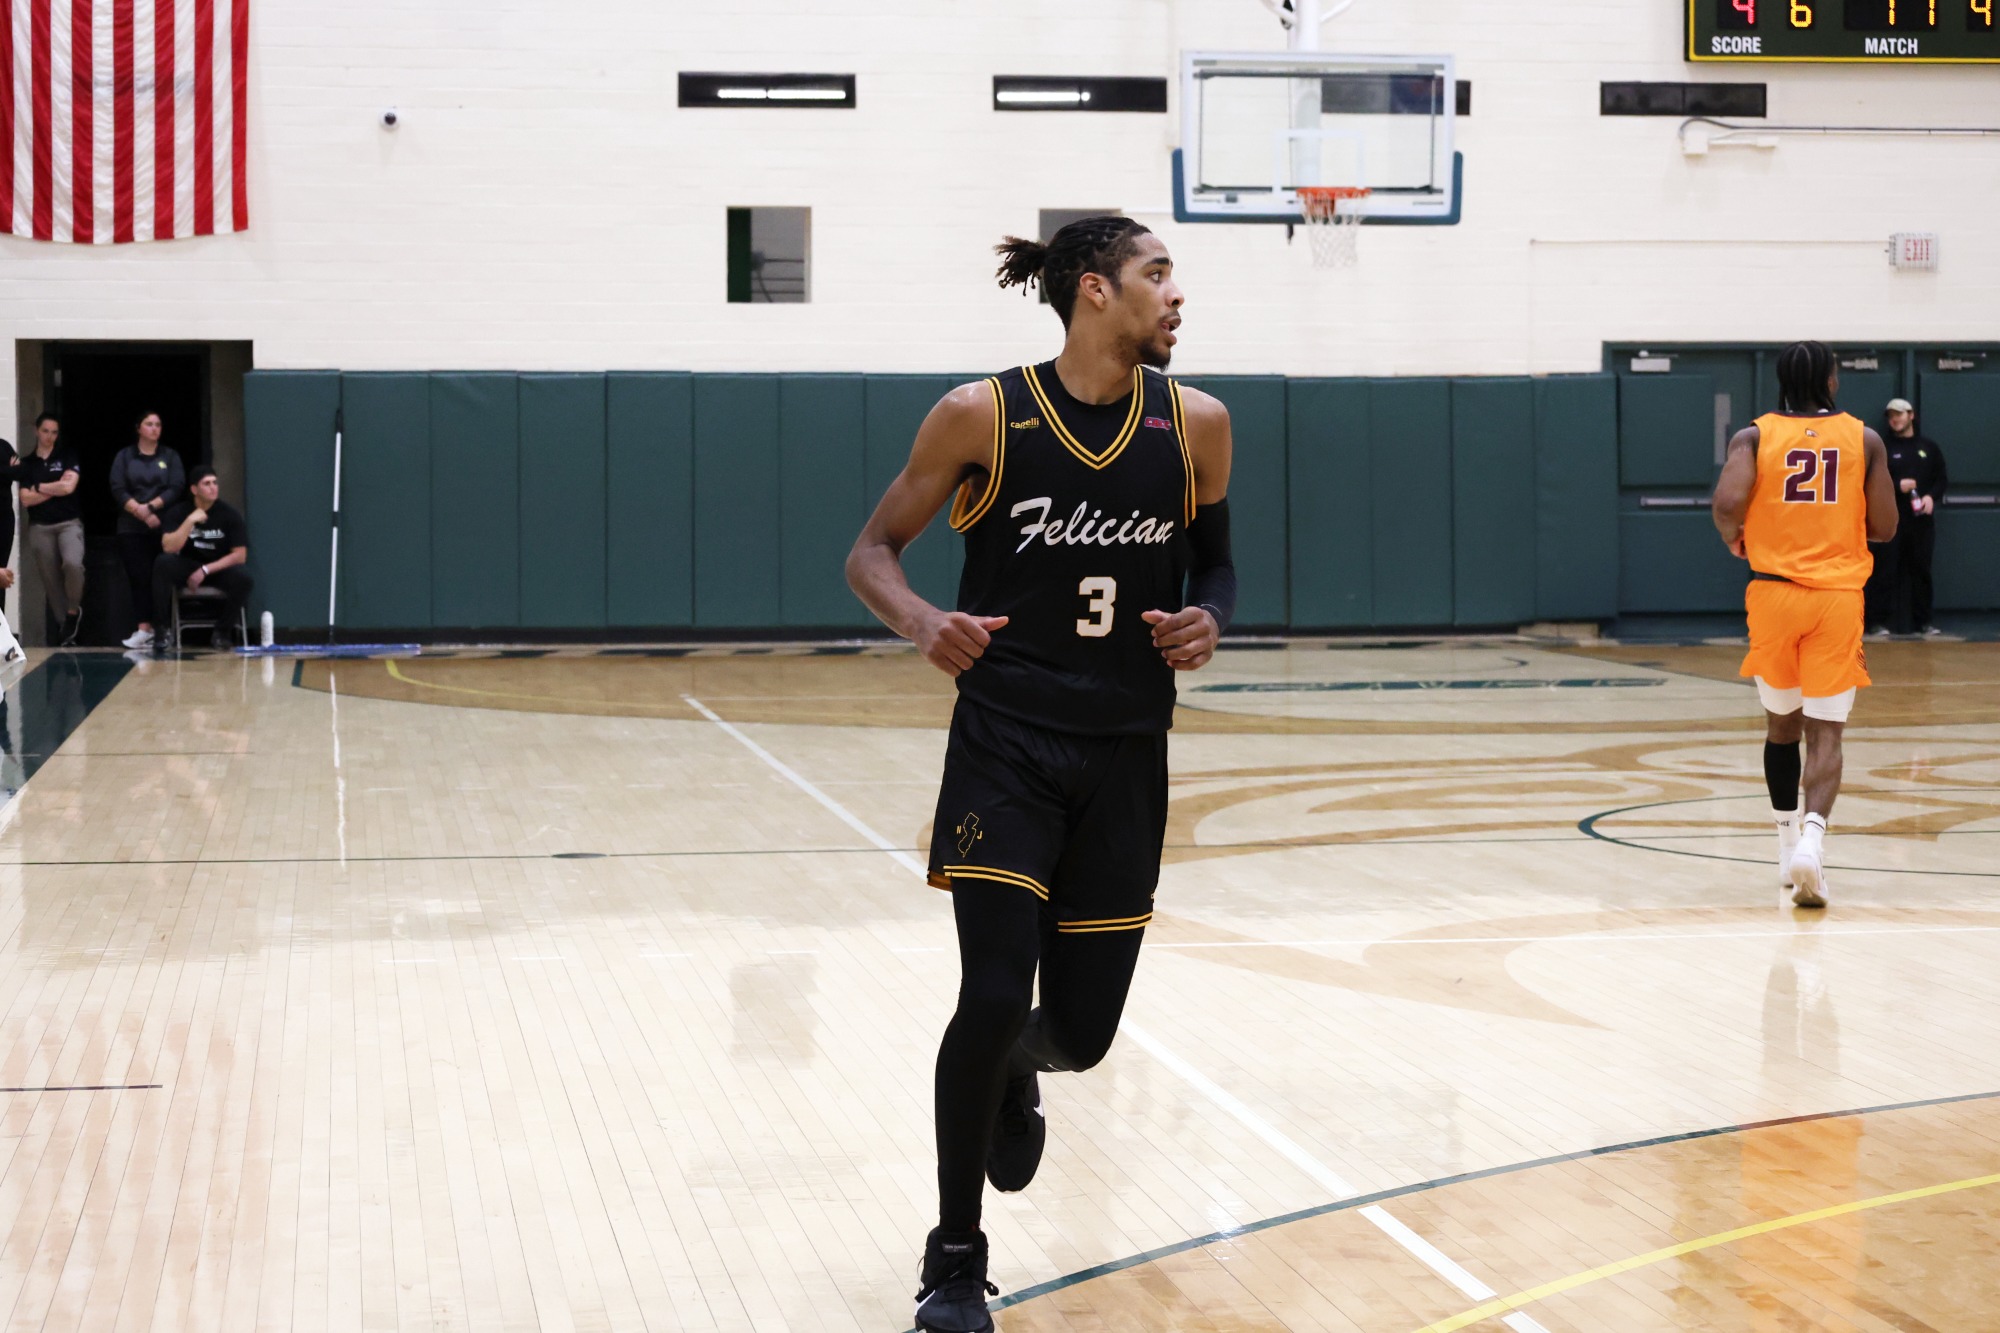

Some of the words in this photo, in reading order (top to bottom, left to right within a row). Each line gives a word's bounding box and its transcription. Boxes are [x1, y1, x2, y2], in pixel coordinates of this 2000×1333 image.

[1711, 35, 1762, 54] SCORE
[1864, 37, 1919, 55] MATCH
[1904, 238, 1932, 262] EXIT
[1783, 448, 1840, 504] 21
[1010, 496, 1174, 554] Felician
[1076, 576, 1117, 637] 3
